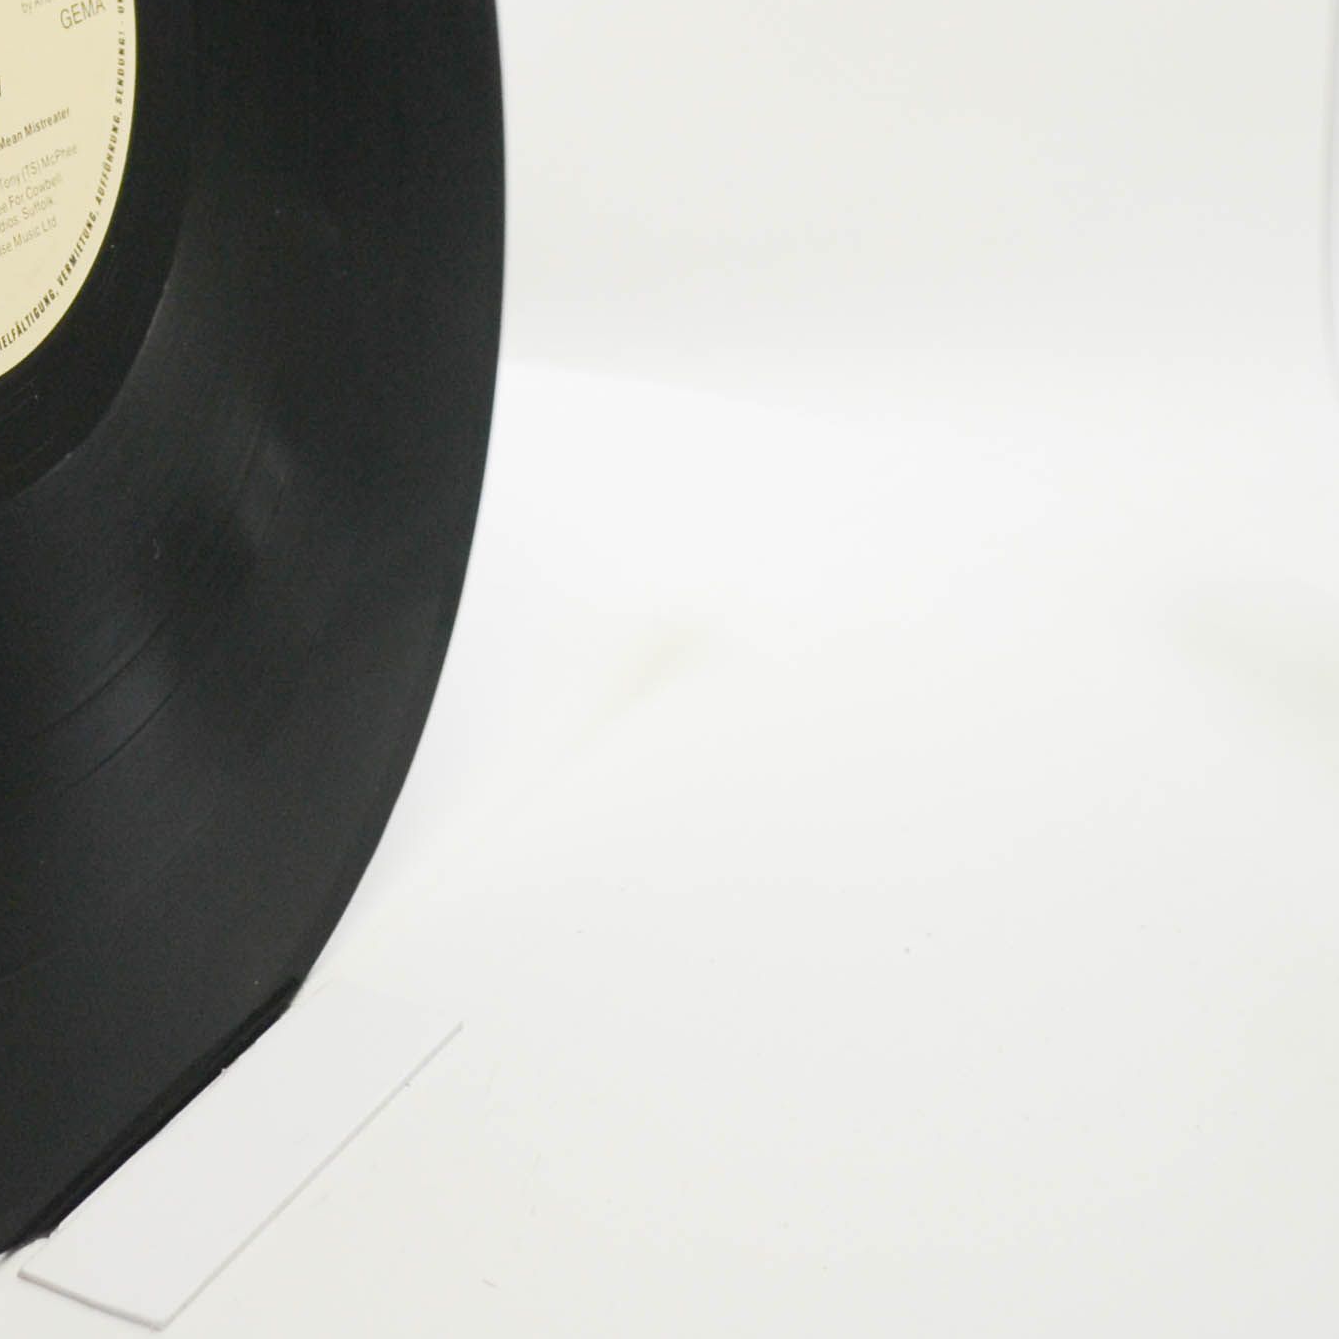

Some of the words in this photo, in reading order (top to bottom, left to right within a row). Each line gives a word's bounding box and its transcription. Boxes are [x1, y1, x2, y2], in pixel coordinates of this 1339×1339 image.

[24, 107, 71, 137] Mistreater
[22, 160, 40, 181] (TS)
[8, 192, 23, 209] For
[13, 225, 41, 247] Music
[56, 211, 100, 286] VERMIETUNG,
